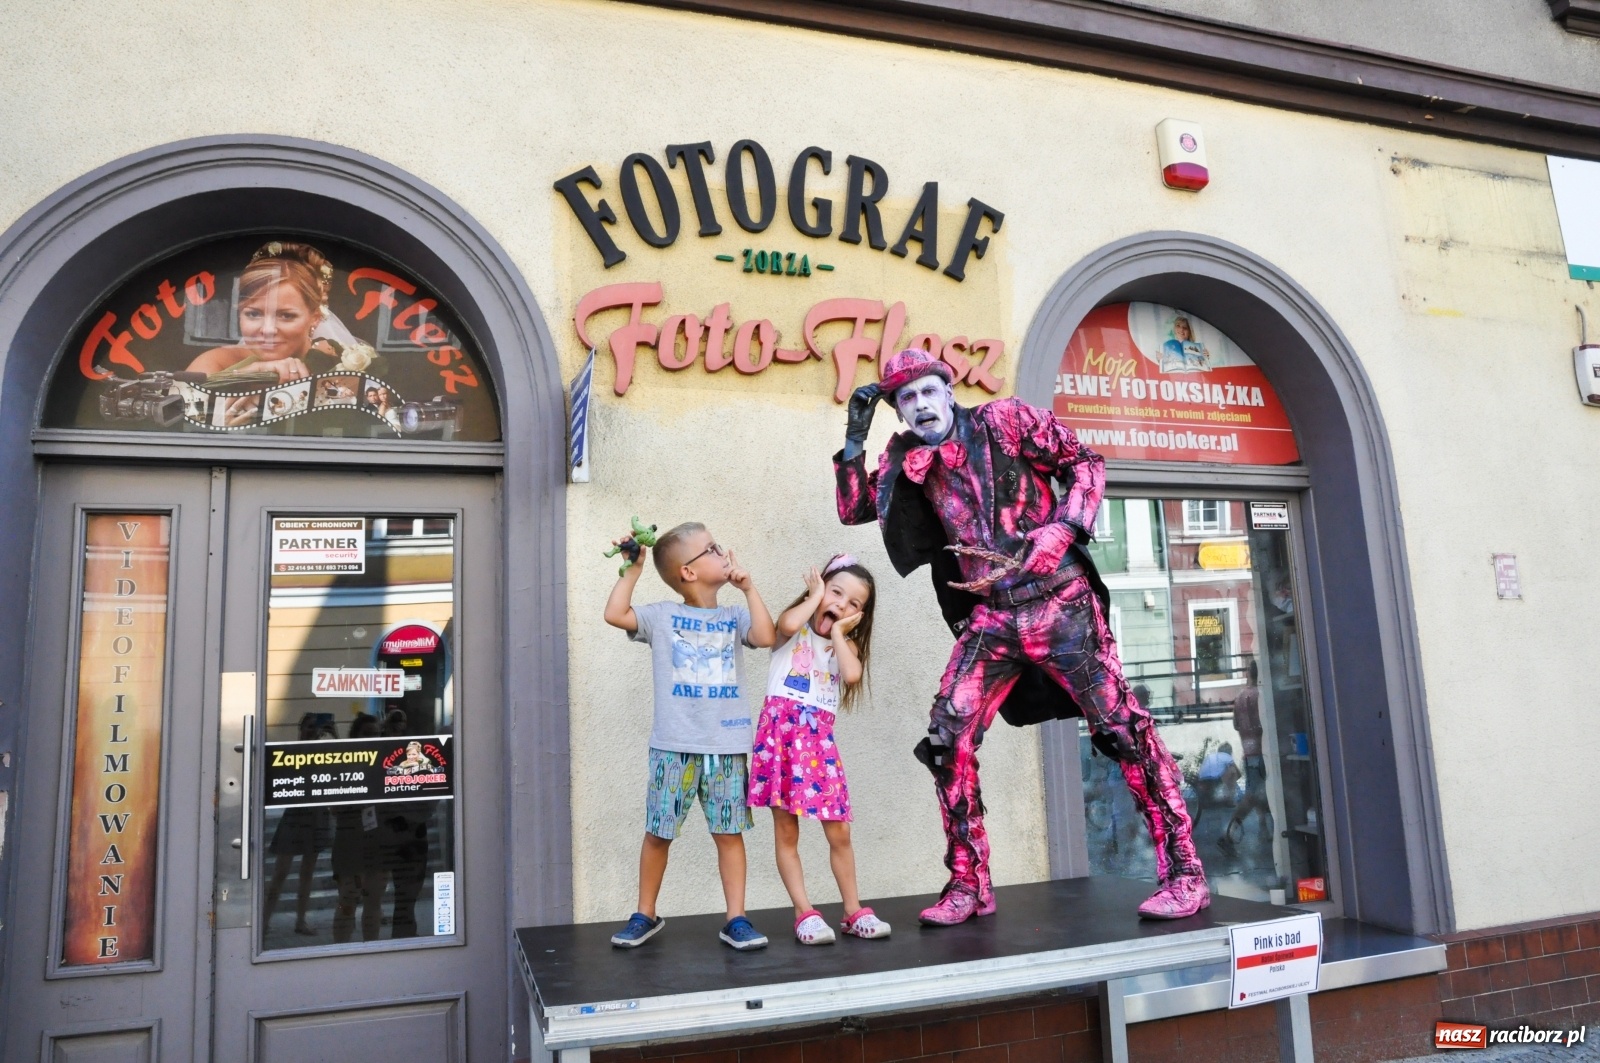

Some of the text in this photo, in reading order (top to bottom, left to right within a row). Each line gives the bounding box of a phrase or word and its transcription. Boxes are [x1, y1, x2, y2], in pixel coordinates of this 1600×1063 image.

[553, 138, 1005, 283] FOTOGRAF
[742, 248, 812, 277] ZORZA
[79, 267, 479, 394] Foto Flesz
[1082, 347, 1138, 390] Moja
[1119, 377, 1265, 410] FOTOKSIĄŻKA
[1067, 402, 1252, 424] Prawdziwa książka z Twoimi zdjęciami
[1076, 428, 1239, 452] www.fotojoker.pl
[311, 521, 359, 529] CHRONIONY
[279, 538, 358, 549] PARTNER
[671, 615, 702, 631] THE
[316, 673, 400, 694] ZAMKNIĘTE
[672, 684, 739, 699] ARE BACK
[98, 521, 141, 959] VIDEOFILMOWANIE
[272, 750, 378, 769] Zapraszamy
[383, 744, 447, 769] Foto Flesz
[272, 776, 305, 787] pon-pt:
[311, 774, 331, 783] 9.00
[339, 772, 365, 781] 17.00
[384, 774, 447, 785] FOTOJOKER
[384, 784, 421, 793] partner
[272, 785, 369, 798] sobota: na zamówienie
[1254, 930, 1301, 950] Pink is bad
[1269, 964, 1286, 973] Polska
